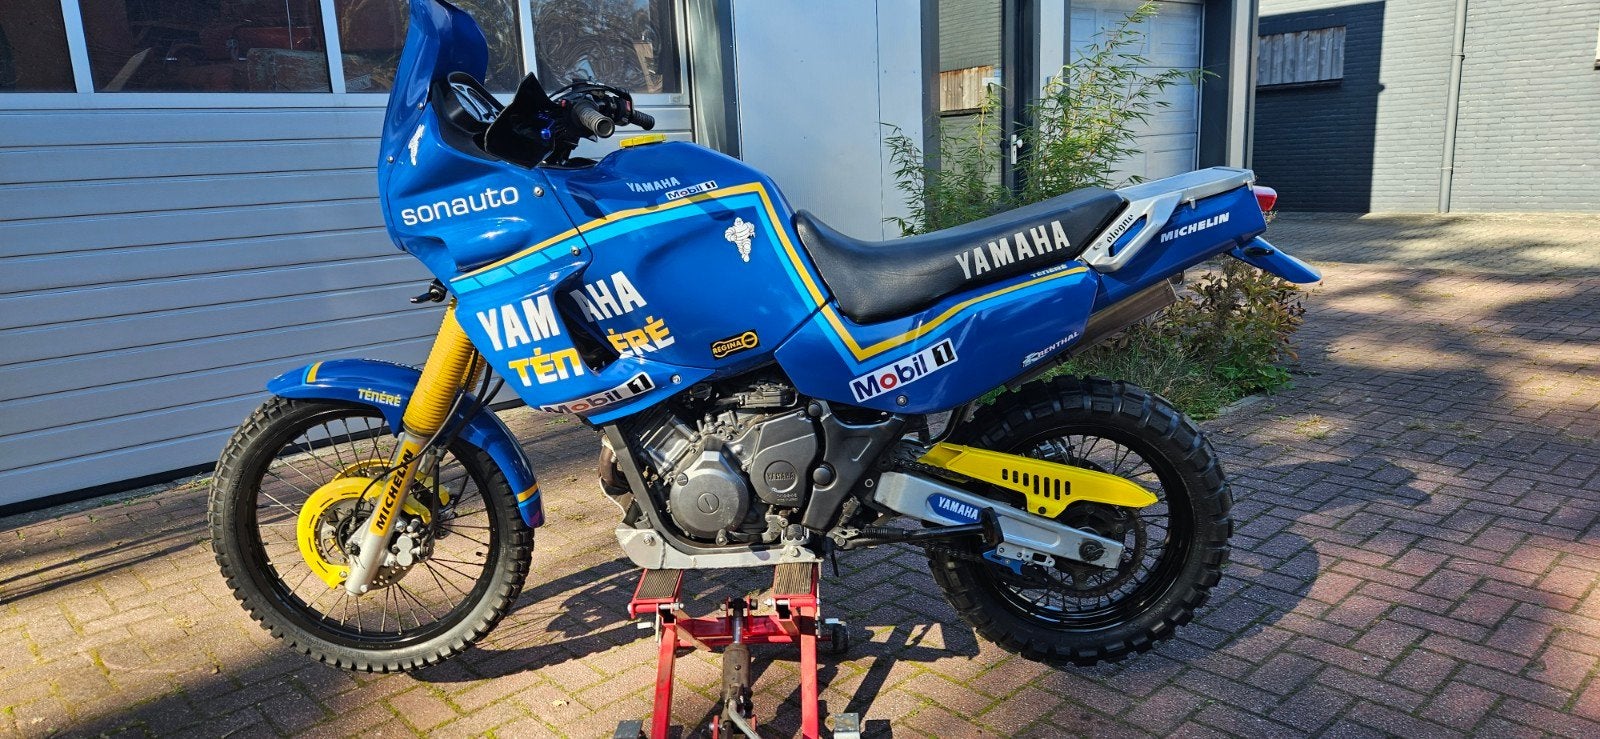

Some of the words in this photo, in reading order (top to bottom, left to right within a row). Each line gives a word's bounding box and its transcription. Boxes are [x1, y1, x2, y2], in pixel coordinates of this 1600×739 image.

[626, 176, 681, 193] YAMAHA
[667, 186, 703, 200] Mobil
[401, 186, 519, 226] sonauto
[1160, 211, 1230, 243] MICHELIN
[954, 220, 1071, 280] YAMAHA
[712, 340, 742, 354] REGINA
[852, 353, 928, 400] Mobil
[541, 389, 622, 414] Mobil
[938, 496, 979, 520] YAMAHA
